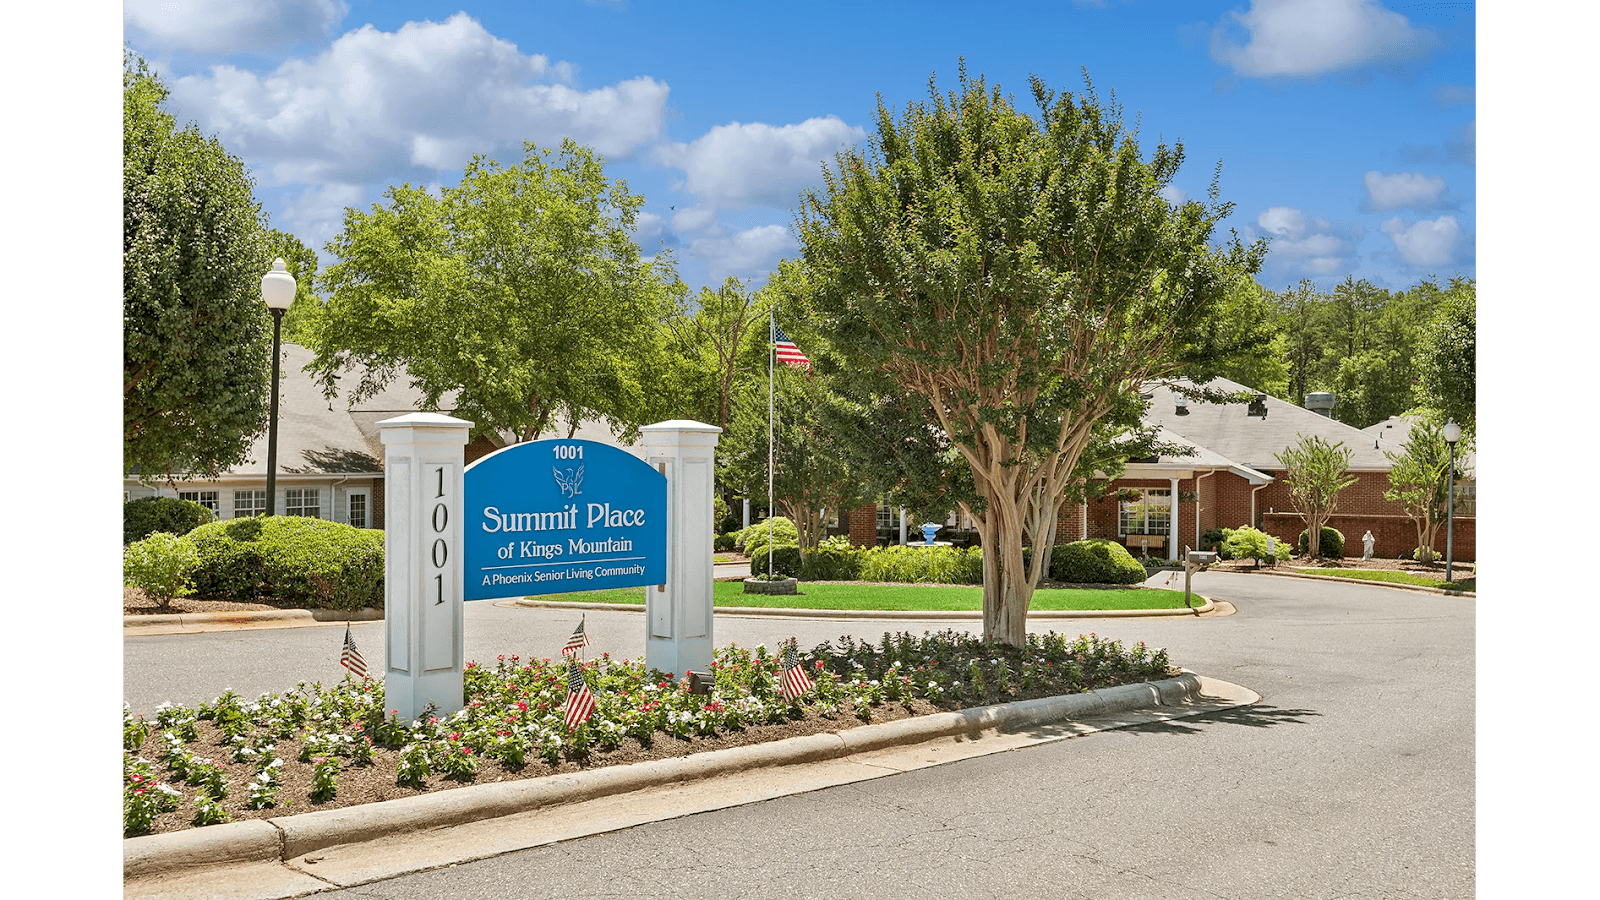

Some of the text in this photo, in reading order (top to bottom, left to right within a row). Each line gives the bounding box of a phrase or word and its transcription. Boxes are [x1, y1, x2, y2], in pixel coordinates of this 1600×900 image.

[553, 445, 583, 459] 1001
[482, 503, 646, 533] Summit Place
[431, 466, 448, 606] 1001
[497, 536, 633, 560] of Kings Mountain
[482, 564, 646, 586] A Phoenix Senior Living Community
